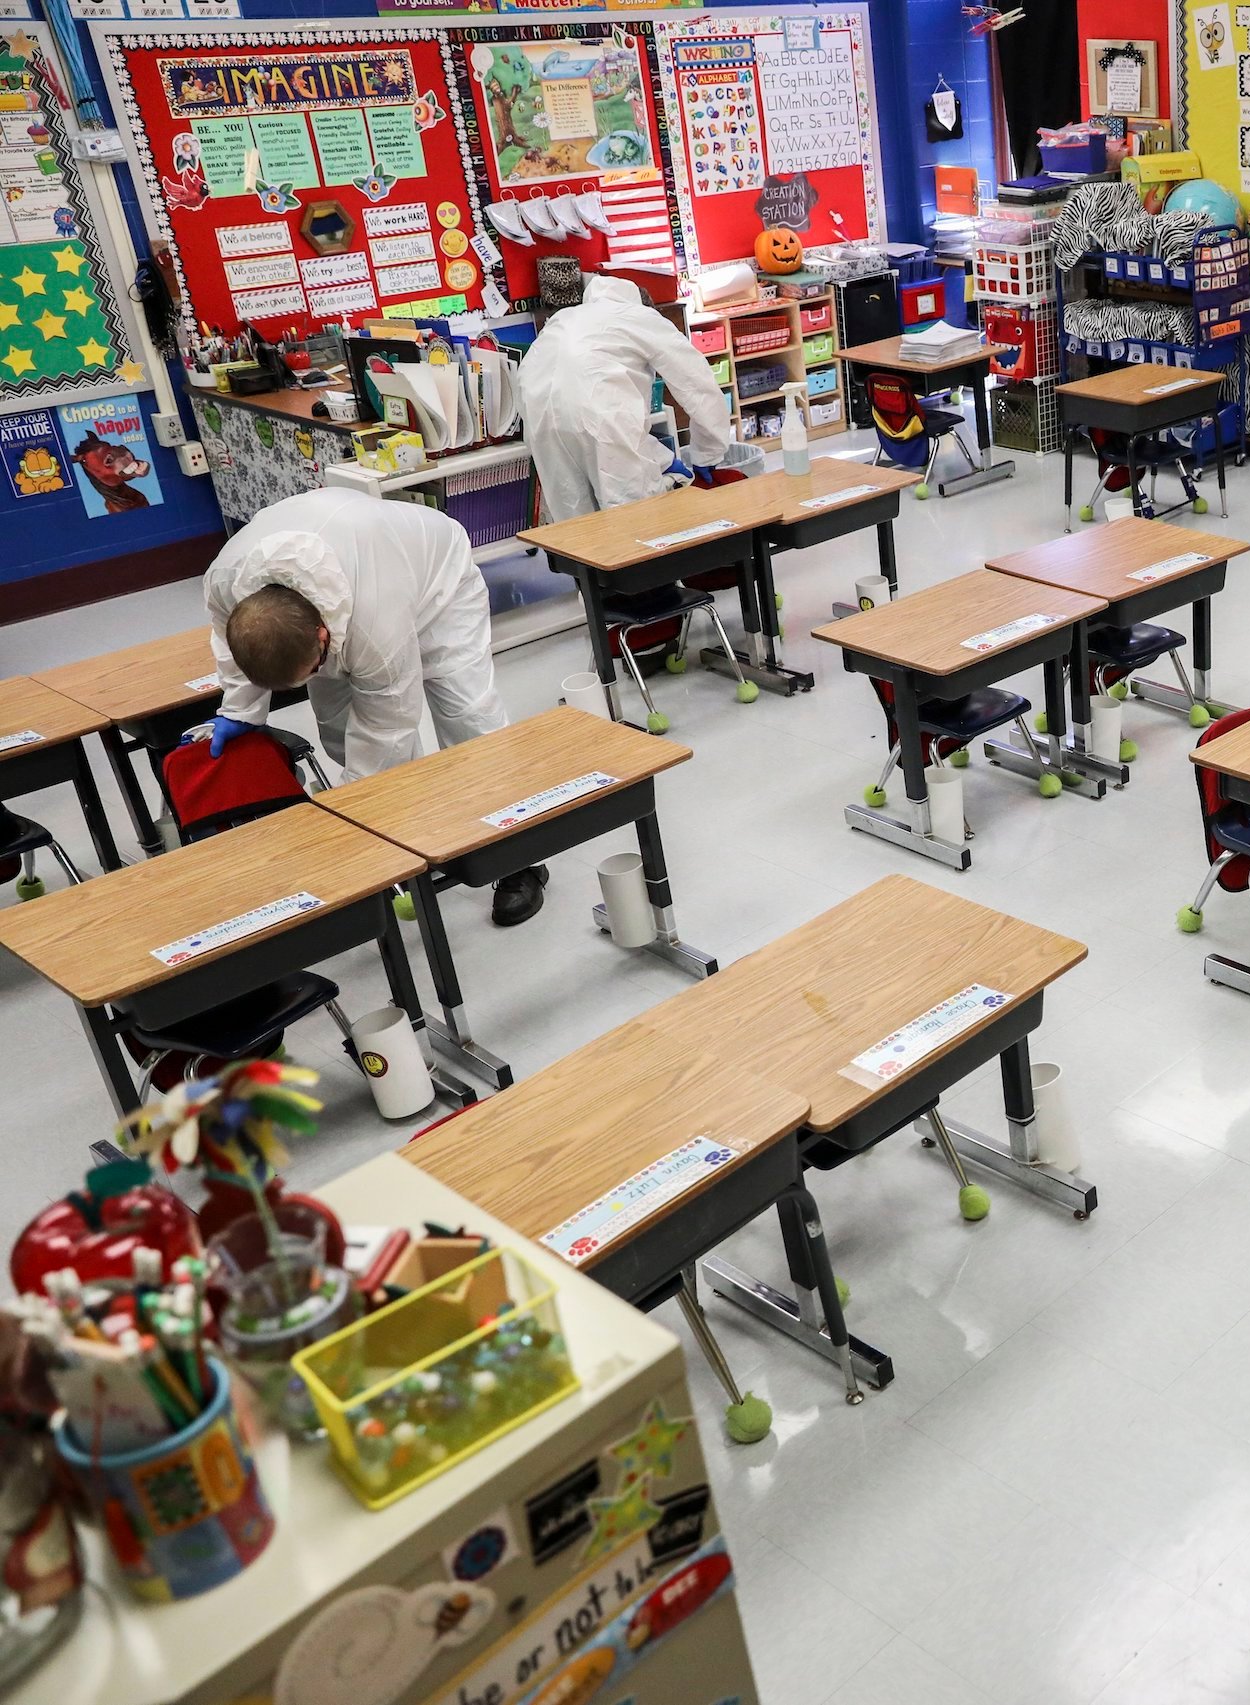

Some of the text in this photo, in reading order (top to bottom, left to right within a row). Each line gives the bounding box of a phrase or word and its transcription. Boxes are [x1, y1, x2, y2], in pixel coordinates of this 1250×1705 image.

[682, 45, 746, 61] WRITING
[761, 48, 849, 67] Aa Bb Cc Dd Ee
[217, 62, 376, 103] IMAGINE
[698, 73, 738, 84] ALPHABET
[764, 69, 851, 94] Ff Gg Hh Ii Jj Kk
[766, 90, 853, 111] Ll Mm Nn Oo Pp
[224, 123, 244, 133] YOU
[769, 111, 855, 137] Qq Rr Ss Tt Uu
[275, 128, 302, 136] FOCUSED
[202, 145, 227, 153] STRONG
[771, 132, 857, 153] Vv Ww Xx Yy Zz
[763, 183, 805, 200] CREATION
[762, 200, 805, 220] STATION
[368, 215, 383, 226] We
[384, 215, 407, 224] work
[223, 230, 283, 244] We belong
[375, 242, 389, 252] We
[389, 242, 410, 251] listen
[473, 236, 494, 264] have
[231, 261, 292, 275] We encourage
[305, 266, 333, 278] We try
[246, 270, 292, 283] each other
[404, 276, 417, 286] for
[238, 299, 254, 310] We
[270, 297, 287, 309] give
[312, 297, 327, 308] We
[22, 412, 48, 425] YOUR
[61, 402, 137, 424] Choose to be
[1, 421, 53, 442] ATTITUDE
[94, 416, 142, 436] happy
[8, 440, 25, 449] have
[25, 440, 36, 448] my
[122, 432, 145, 444] today.
[945, 999, 978, 1017] Chase
[628, 1153, 702, 1198] Gavin Lutz
[515, 1644, 545, 1686] or
[555, 1584, 608, 1655] not
